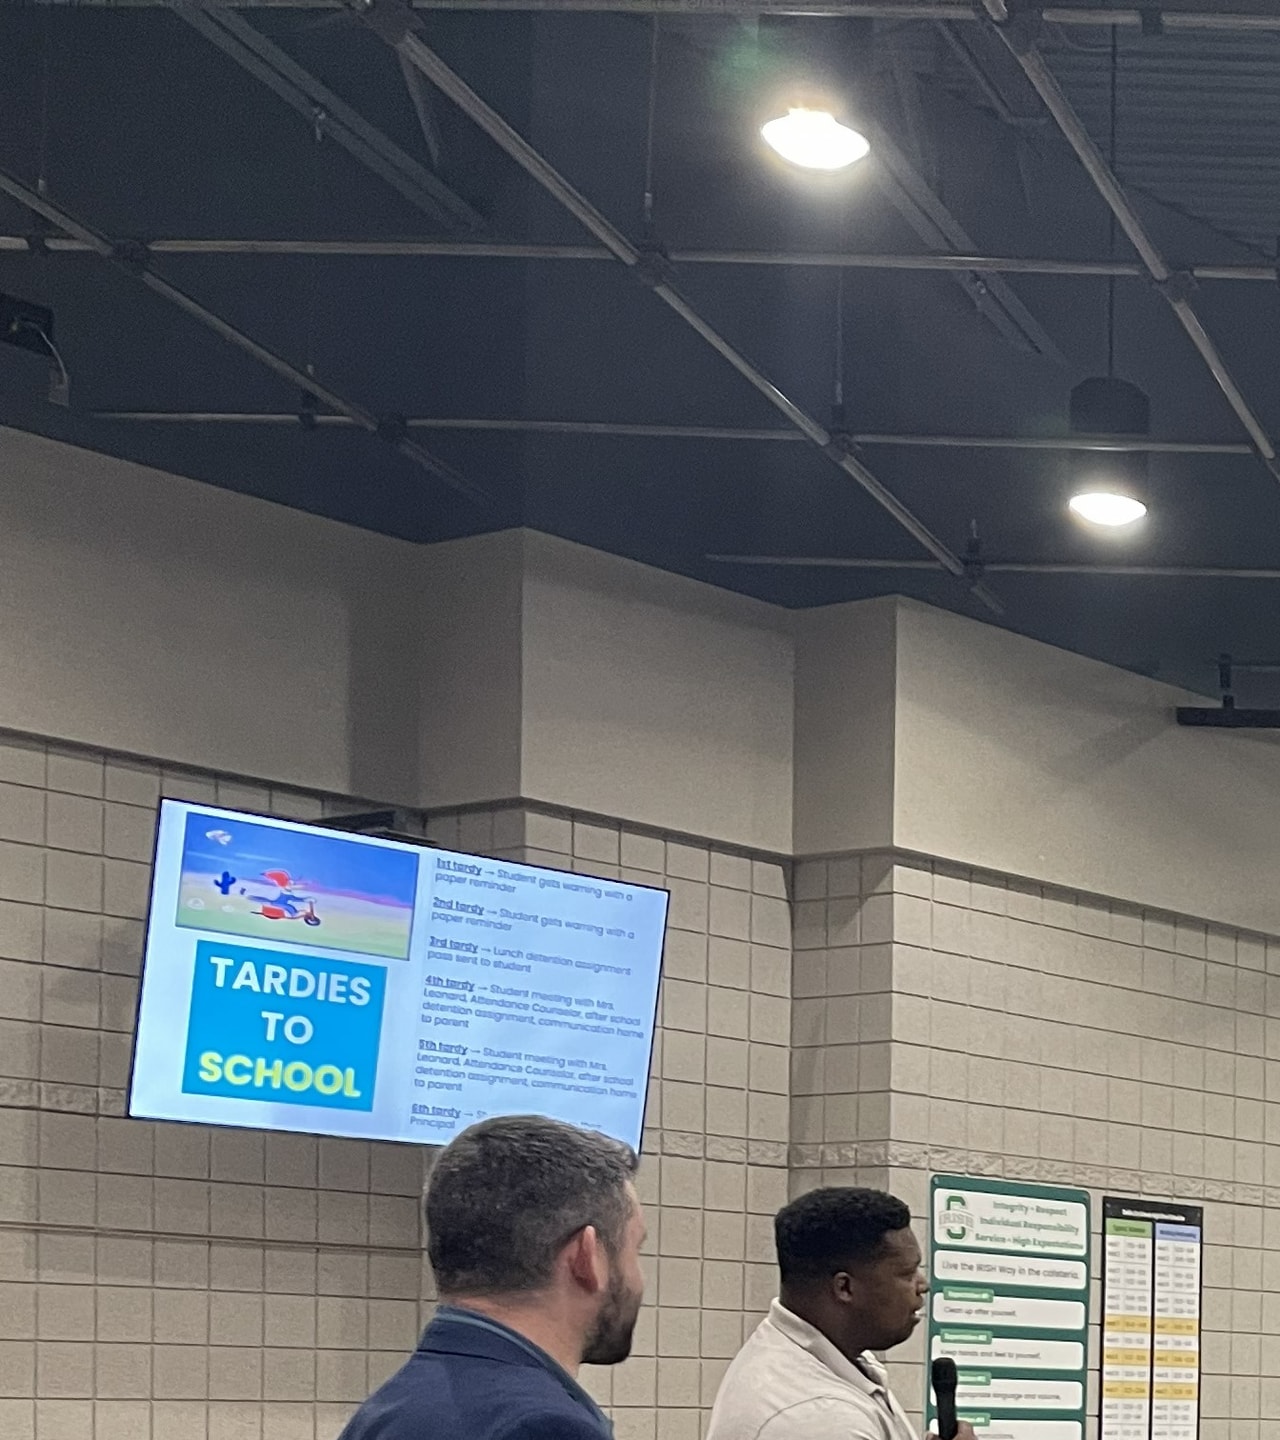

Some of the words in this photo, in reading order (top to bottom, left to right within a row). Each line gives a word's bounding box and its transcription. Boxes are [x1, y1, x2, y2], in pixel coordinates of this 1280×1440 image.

[435, 872, 466, 886] paper
[469, 878, 516, 893] reminder
[453, 860, 482, 877] tardy
[497, 869, 536, 884] Student
[539, 878, 560, 890] gets
[562, 881, 602, 899] warning
[605, 889, 624, 900] with
[431, 911, 463, 925] paper
[466, 916, 512, 931] reminder
[433, 897, 453, 911] 2nd
[455, 900, 484, 916] tardy
[500, 908, 538, 924] Student
[541, 917, 562, 928] gets
[565, 921, 603, 937] warning
[606, 927, 626, 938] with
[450, 939, 478, 955] tardy
[493, 946, 523, 959] Lunch
[526, 951, 572, 967] detention
[575, 961, 631, 976] assignment
[456, 954, 477, 966] sent
[480, 959, 490, 968] to
[493, 961, 531, 973] student
[210, 956, 371, 1006] TARDIES
[425, 975, 443, 988] 4th
[446, 978, 475, 993] tardy
[490, 984, 529, 997] Student
[531, 991, 572, 1007] meeting
[575, 998, 594, 1008] with
[421, 1014, 432, 1024] to
[434, 1017, 469, 1030] parent
[423, 1001, 472, 1016] detention
[538, 1017, 614, 1035] communication
[617, 1027, 644, 1039] home
[470, 995, 529, 1011] Attendance
[585, 1011, 608, 1021] after
[610, 1015, 640, 1026] school
[261, 1011, 314, 1045] TO
[439, 1043, 468, 1056] tardy
[483, 1048, 522, 1060] Student
[524, 1053, 565, 1069] meeting
[568, 1059, 587, 1069] with
[198, 1051, 361, 1098] SCHOOL
[415, 1065, 465, 1079] detention
[531, 1079, 607, 1096] communication
[609, 1088, 637, 1099] home
[463, 1058, 522, 1073] Attendance
[578, 1072, 601, 1082] after
[603, 1075, 633, 1086] school
[414, 1078, 425, 1088] to
[427, 1082, 462, 1094] parent
[410, 1116, 455, 1130] Principal
[432, 1106, 460, 1120] tardy
[993, 1201, 1029, 1215] Integrity
[1036, 1205, 1067, 1216] Respect
[980, 1217, 1022, 1228] Individual
[1023, 1221, 1079, 1236] Responsibility
[975, 1233, 1006, 1243] Service
[1013, 1237, 1030, 1247] High
[1033, 1238, 1083, 1250] Expectations
[942, 1261, 958, 1271] Live
[961, 1262, 974, 1272] the
[976, 1263, 997, 1273] IRISH
[1018, 1266, 1026, 1275] in
[1028, 1268, 1041, 1277] the
